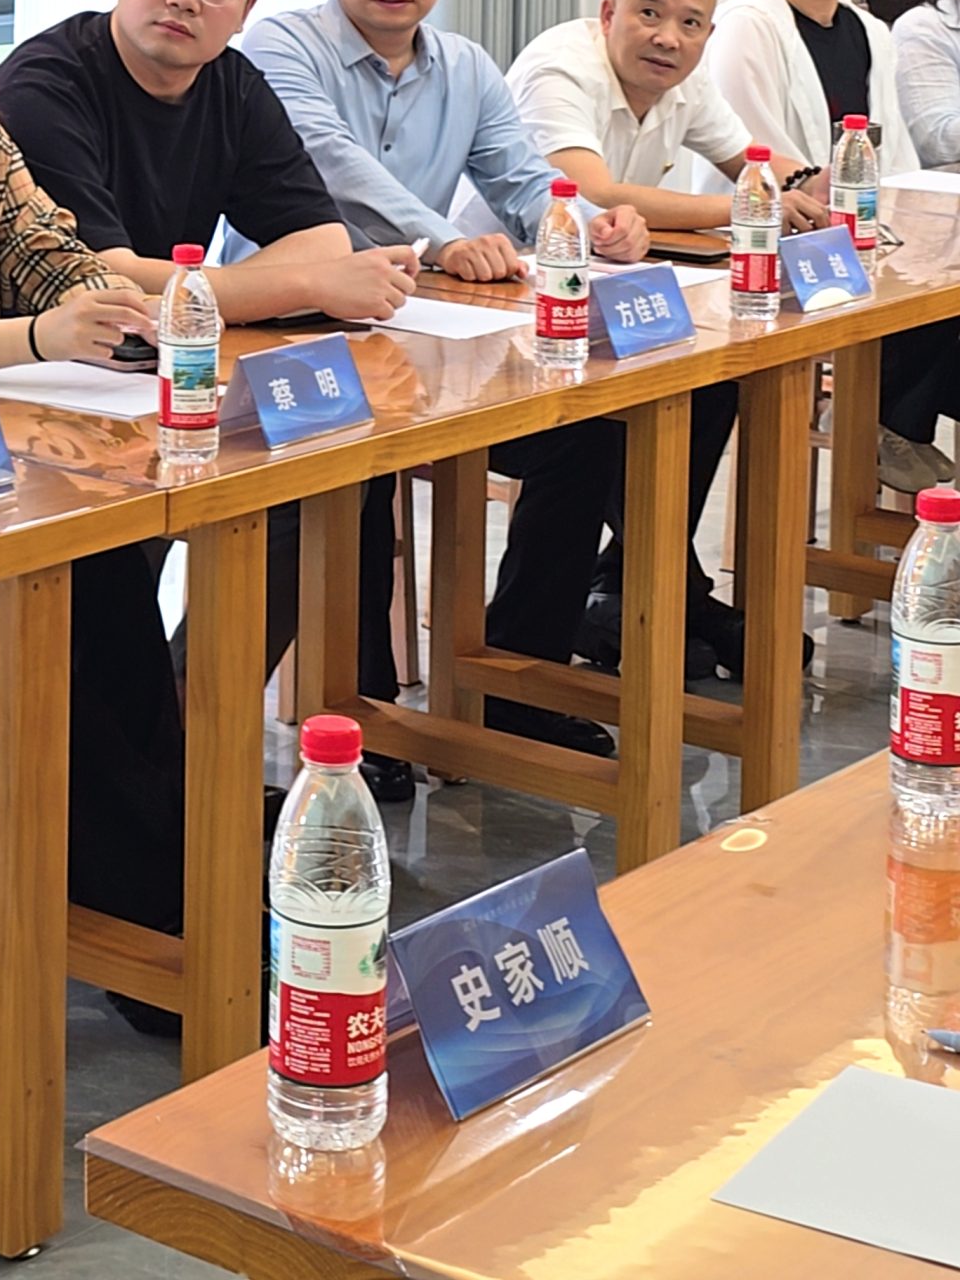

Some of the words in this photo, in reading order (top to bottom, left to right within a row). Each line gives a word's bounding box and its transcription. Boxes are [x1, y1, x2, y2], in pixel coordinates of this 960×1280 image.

[268, 367, 341, 412] 蔡明
[450, 916, 590, 1033] 史家顺
